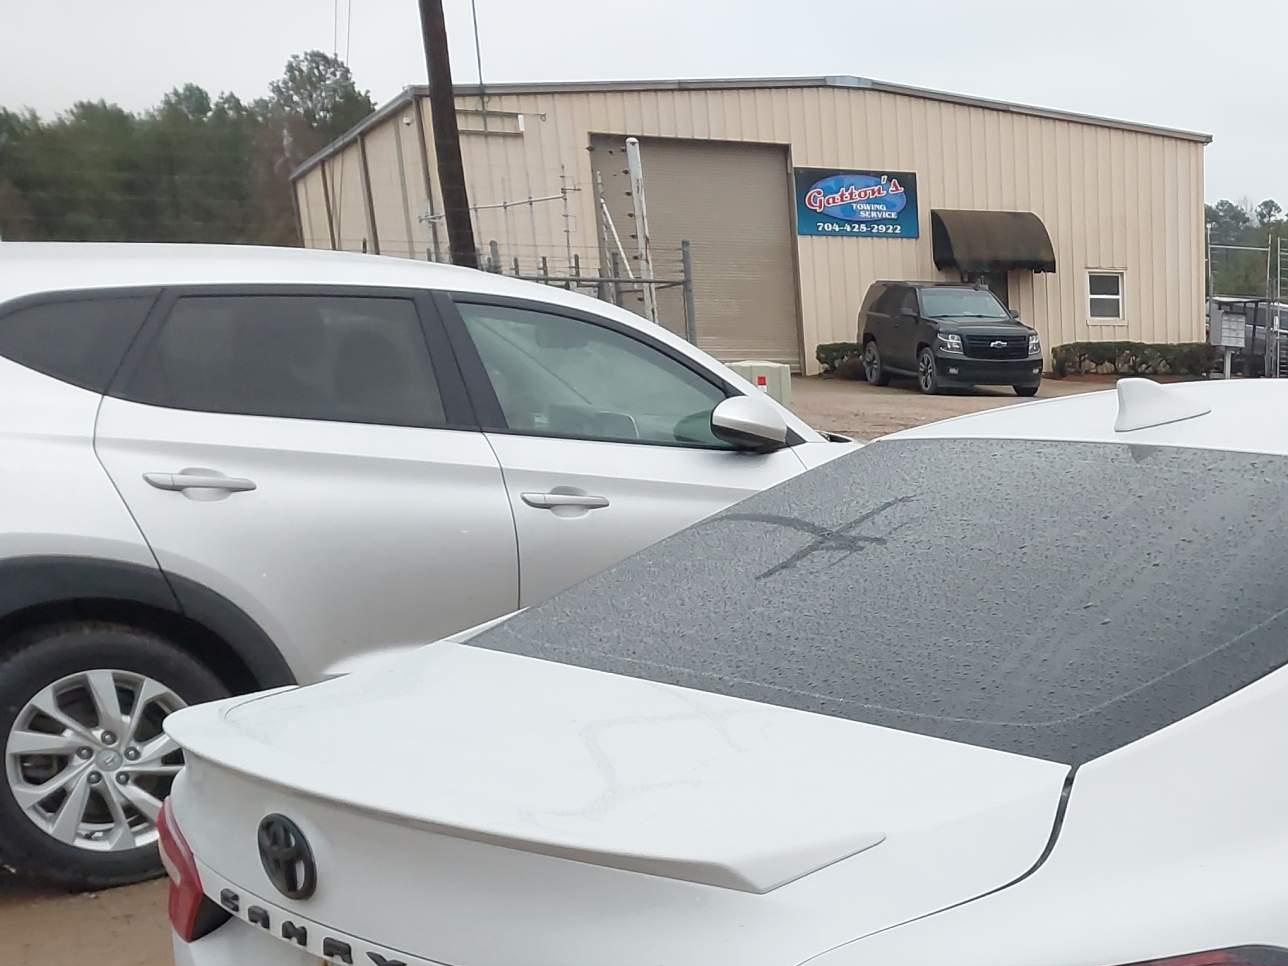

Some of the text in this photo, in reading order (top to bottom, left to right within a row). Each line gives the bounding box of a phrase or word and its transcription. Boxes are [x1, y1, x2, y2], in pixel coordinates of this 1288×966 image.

[805, 175, 904, 212] Gatton's
[851, 203, 886, 211] TOWING
[860, 211, 898, 219] SERVICE
[816, 223, 901, 233] 704-425-2922
